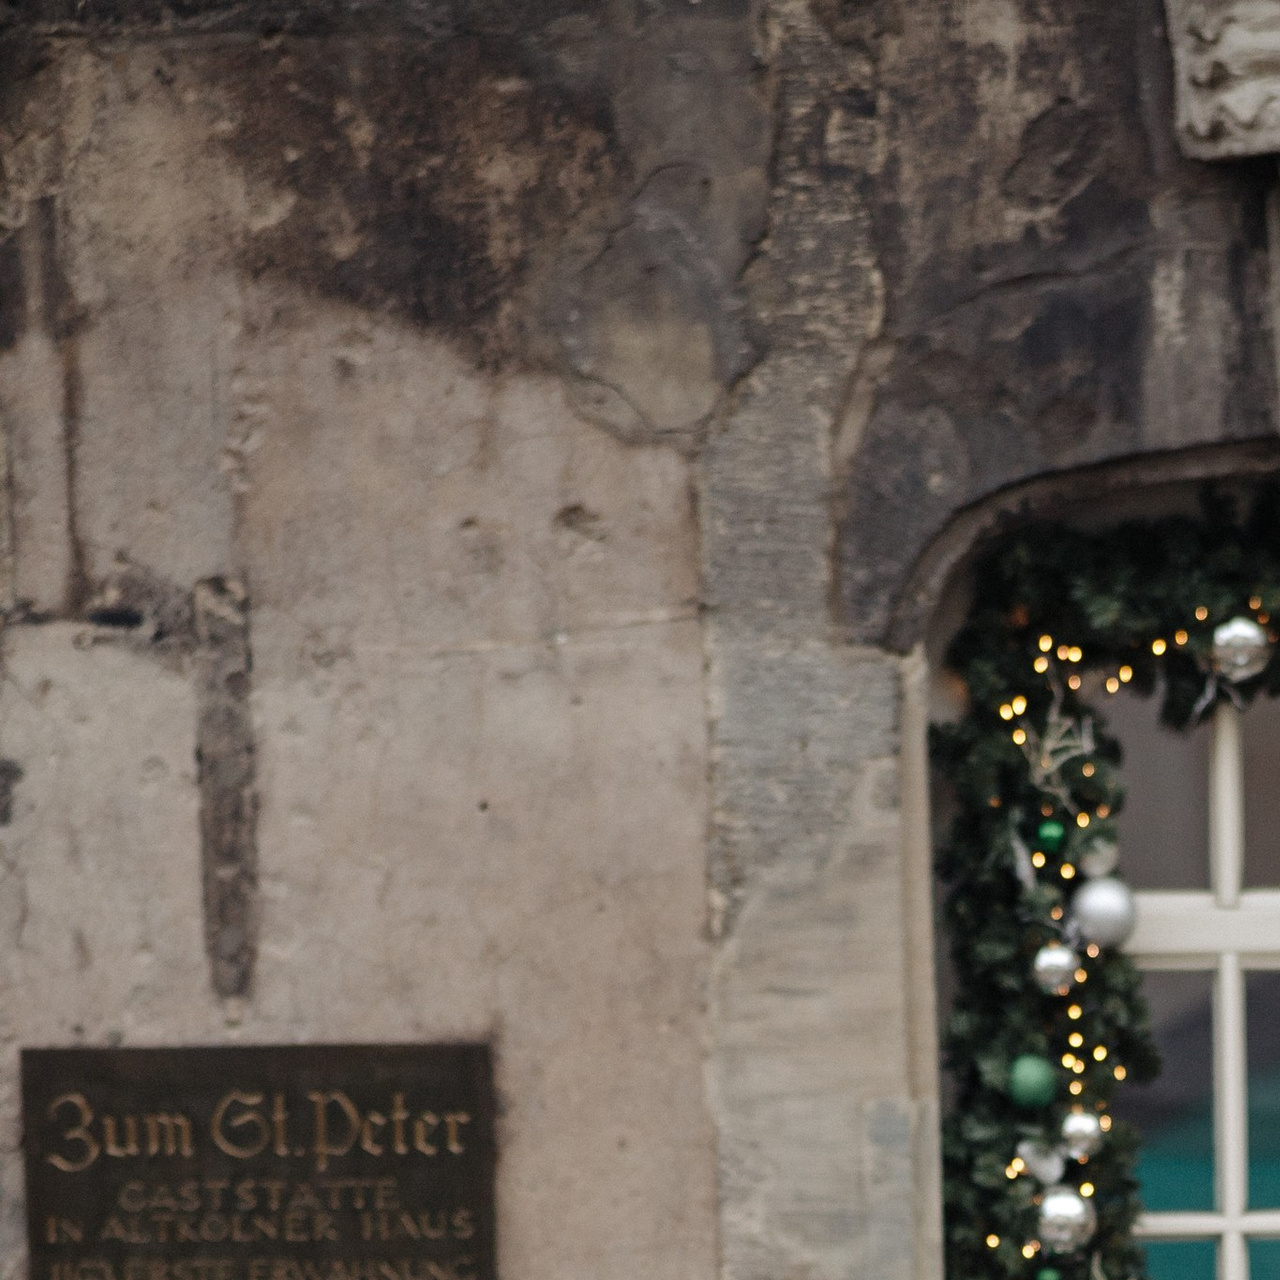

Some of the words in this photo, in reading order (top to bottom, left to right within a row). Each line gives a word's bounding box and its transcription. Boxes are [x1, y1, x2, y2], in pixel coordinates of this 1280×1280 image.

[45, 1092, 195, 1172] Zum
[308, 1089, 471, 1172] Peter
[45, 1216, 84, 1245] IN
[361, 1207, 477, 1240] HAUS
